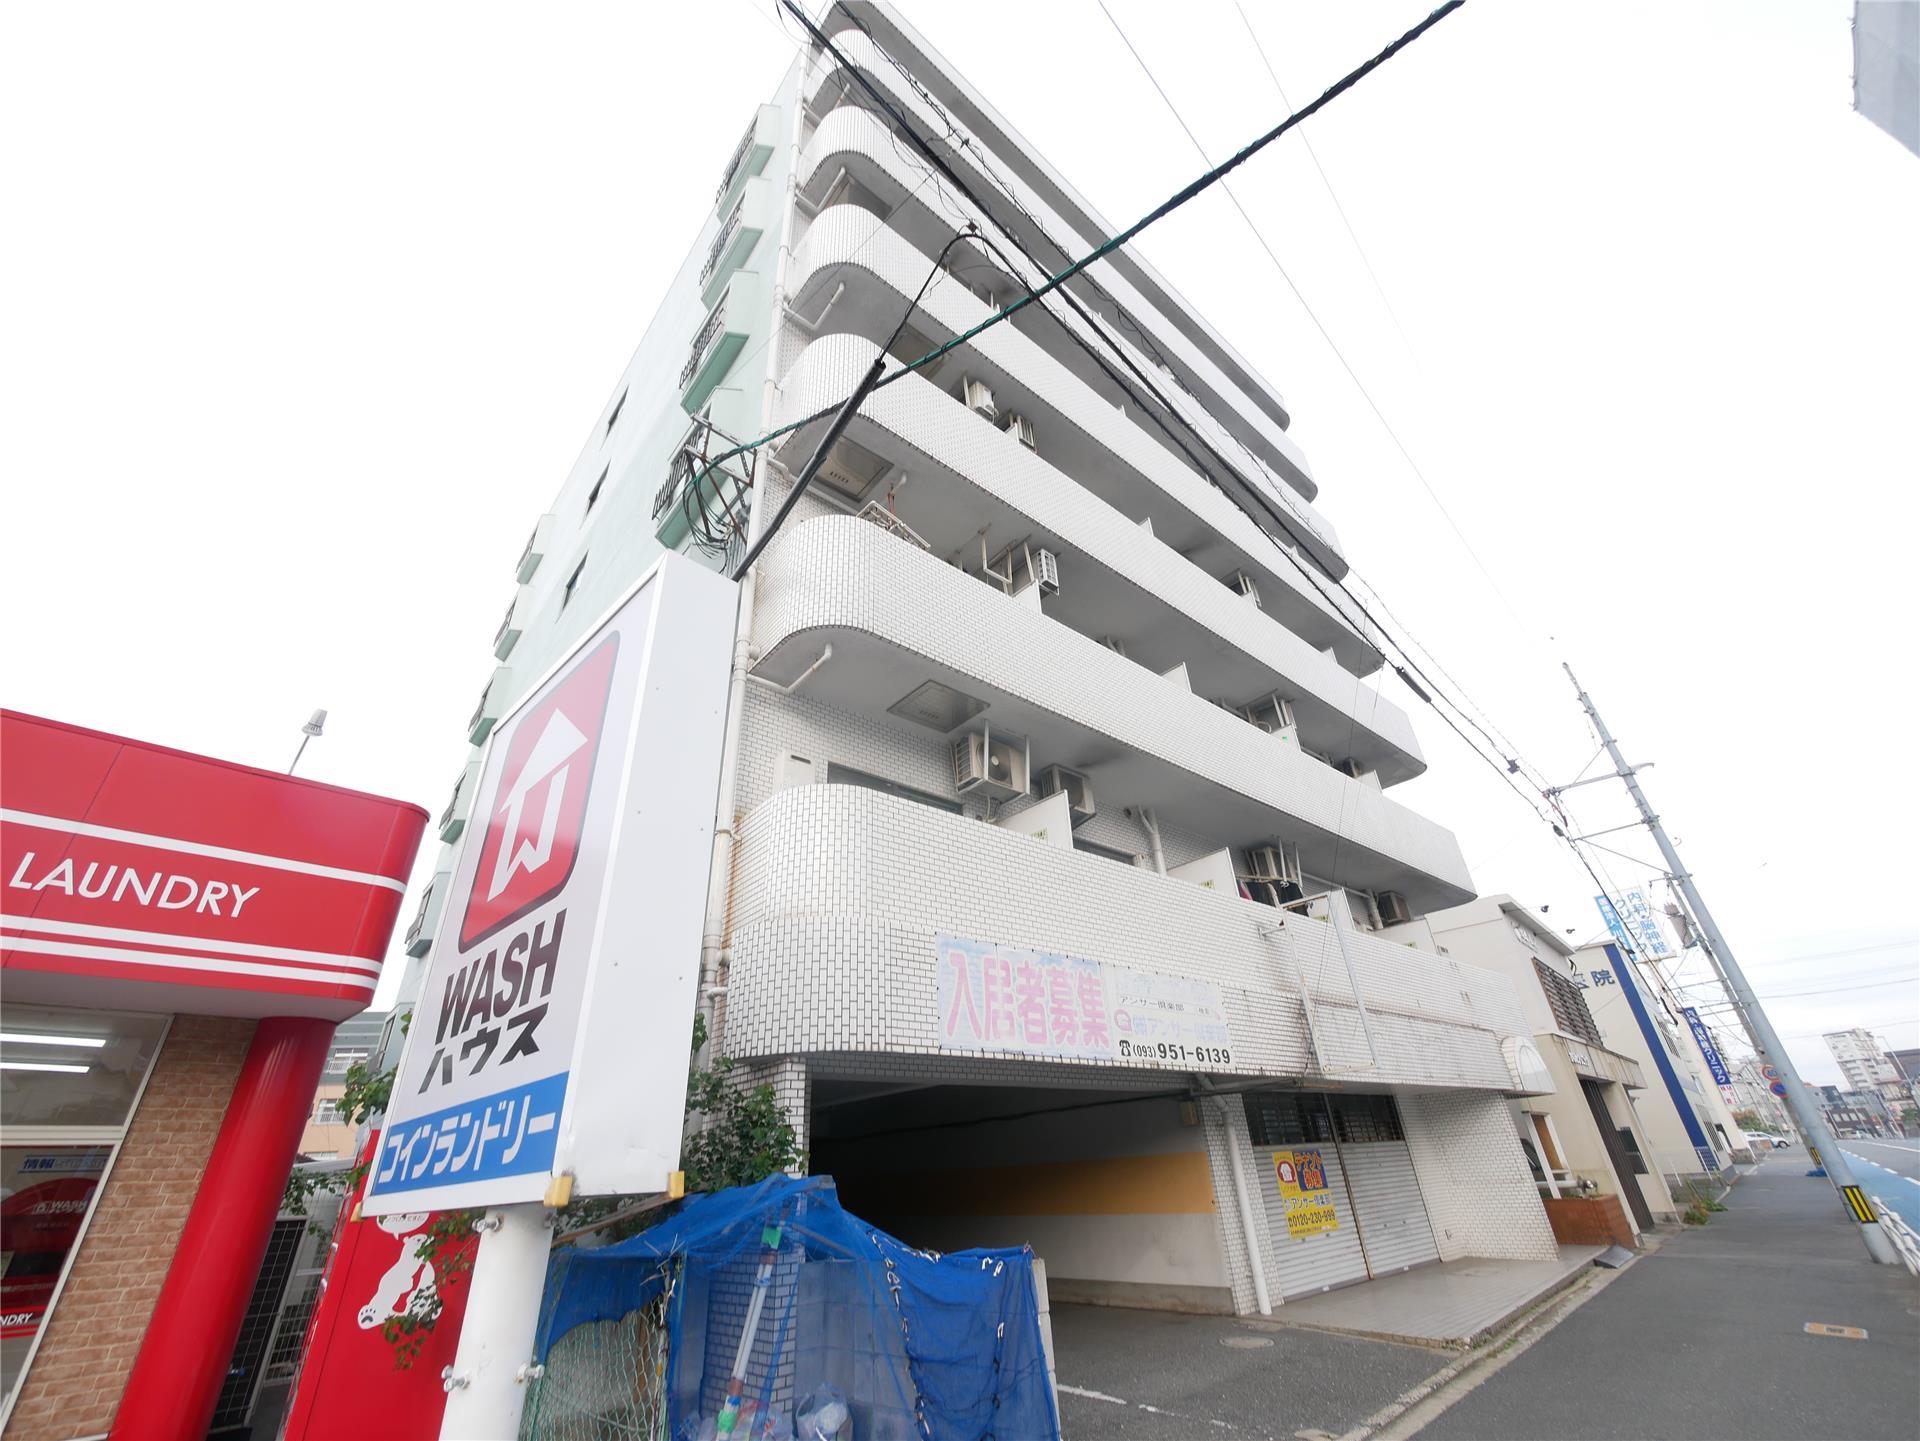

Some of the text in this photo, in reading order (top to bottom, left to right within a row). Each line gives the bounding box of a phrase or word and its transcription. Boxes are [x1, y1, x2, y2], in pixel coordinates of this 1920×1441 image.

[9, 851, 261, 918] LAUNDRY
[434, 907, 567, 1045] WASH
[946, 951, 1110, 1049] 入居者募集
[418, 1003, 549, 1095] ハウス
[378, 1093, 557, 1184] コインランドリー
